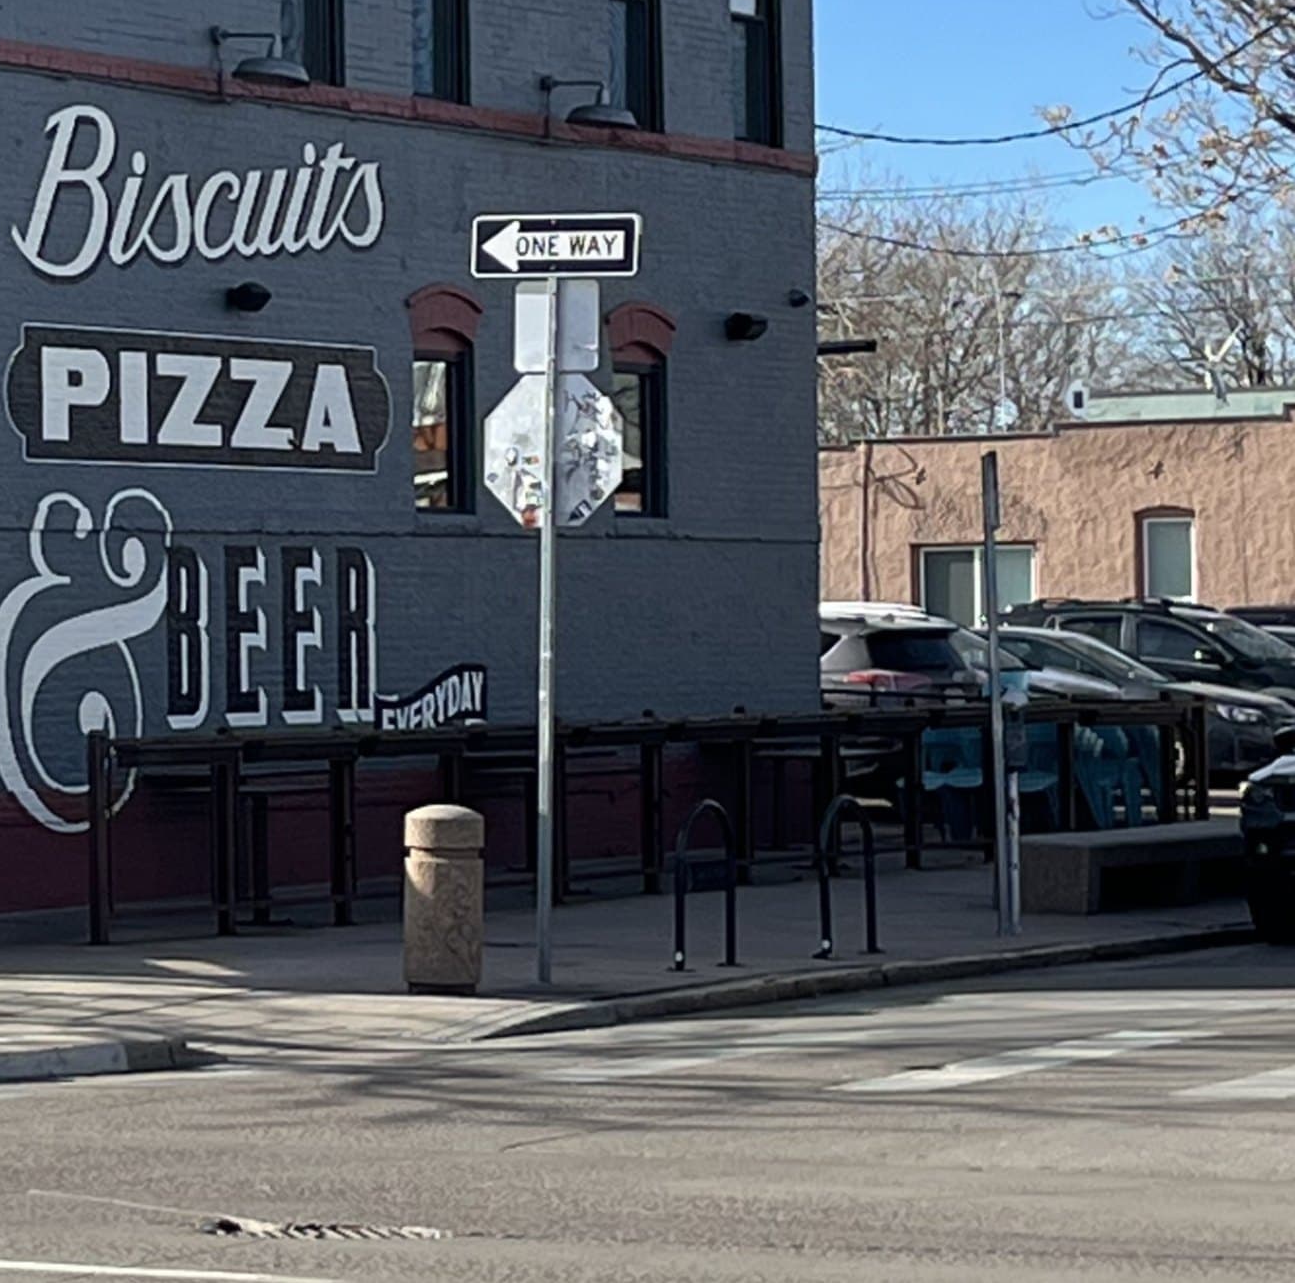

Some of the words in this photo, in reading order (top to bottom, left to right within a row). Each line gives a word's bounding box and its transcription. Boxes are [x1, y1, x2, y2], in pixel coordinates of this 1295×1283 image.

[11, 105, 384, 277] Biscuits
[516, 236, 559, 256] ONE
[569, 234, 617, 257] WAY
[41, 346, 363, 454] PIZZA
[166, 546, 376, 730] BEER
[382, 671, 483, 730] EVERYDAY
